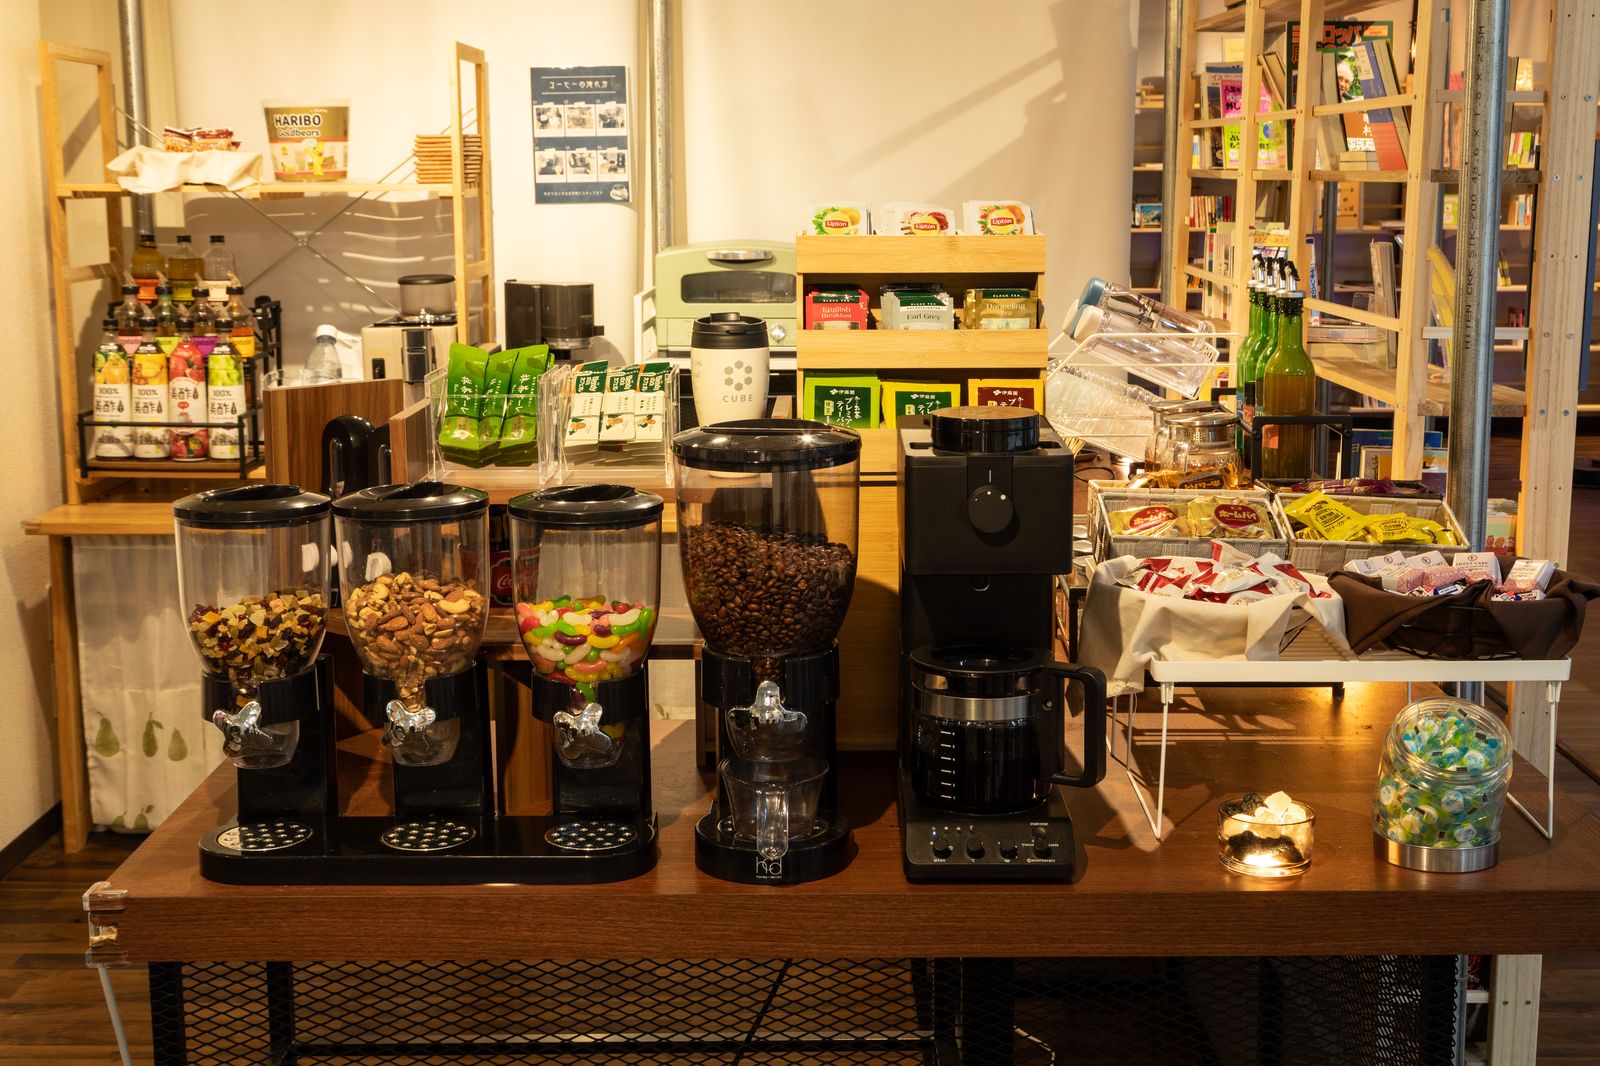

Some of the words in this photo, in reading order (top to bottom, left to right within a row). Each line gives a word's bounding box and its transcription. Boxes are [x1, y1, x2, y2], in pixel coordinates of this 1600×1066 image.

[274, 115, 322, 127] HARIBO
[277, 129, 320, 138] Goldbears
[826, 220, 848, 228] Lipton
[991, 218, 1013, 226] Lipton
[98, 387, 120, 395] 100%
[137, 388, 159, 396] 100%
[212, 389, 232, 397] 100%
[722, 394, 753, 403] CUBE
[844, 396, 854, 428] プレミア
[1219, 509, 1257, 521] ホームパイ
